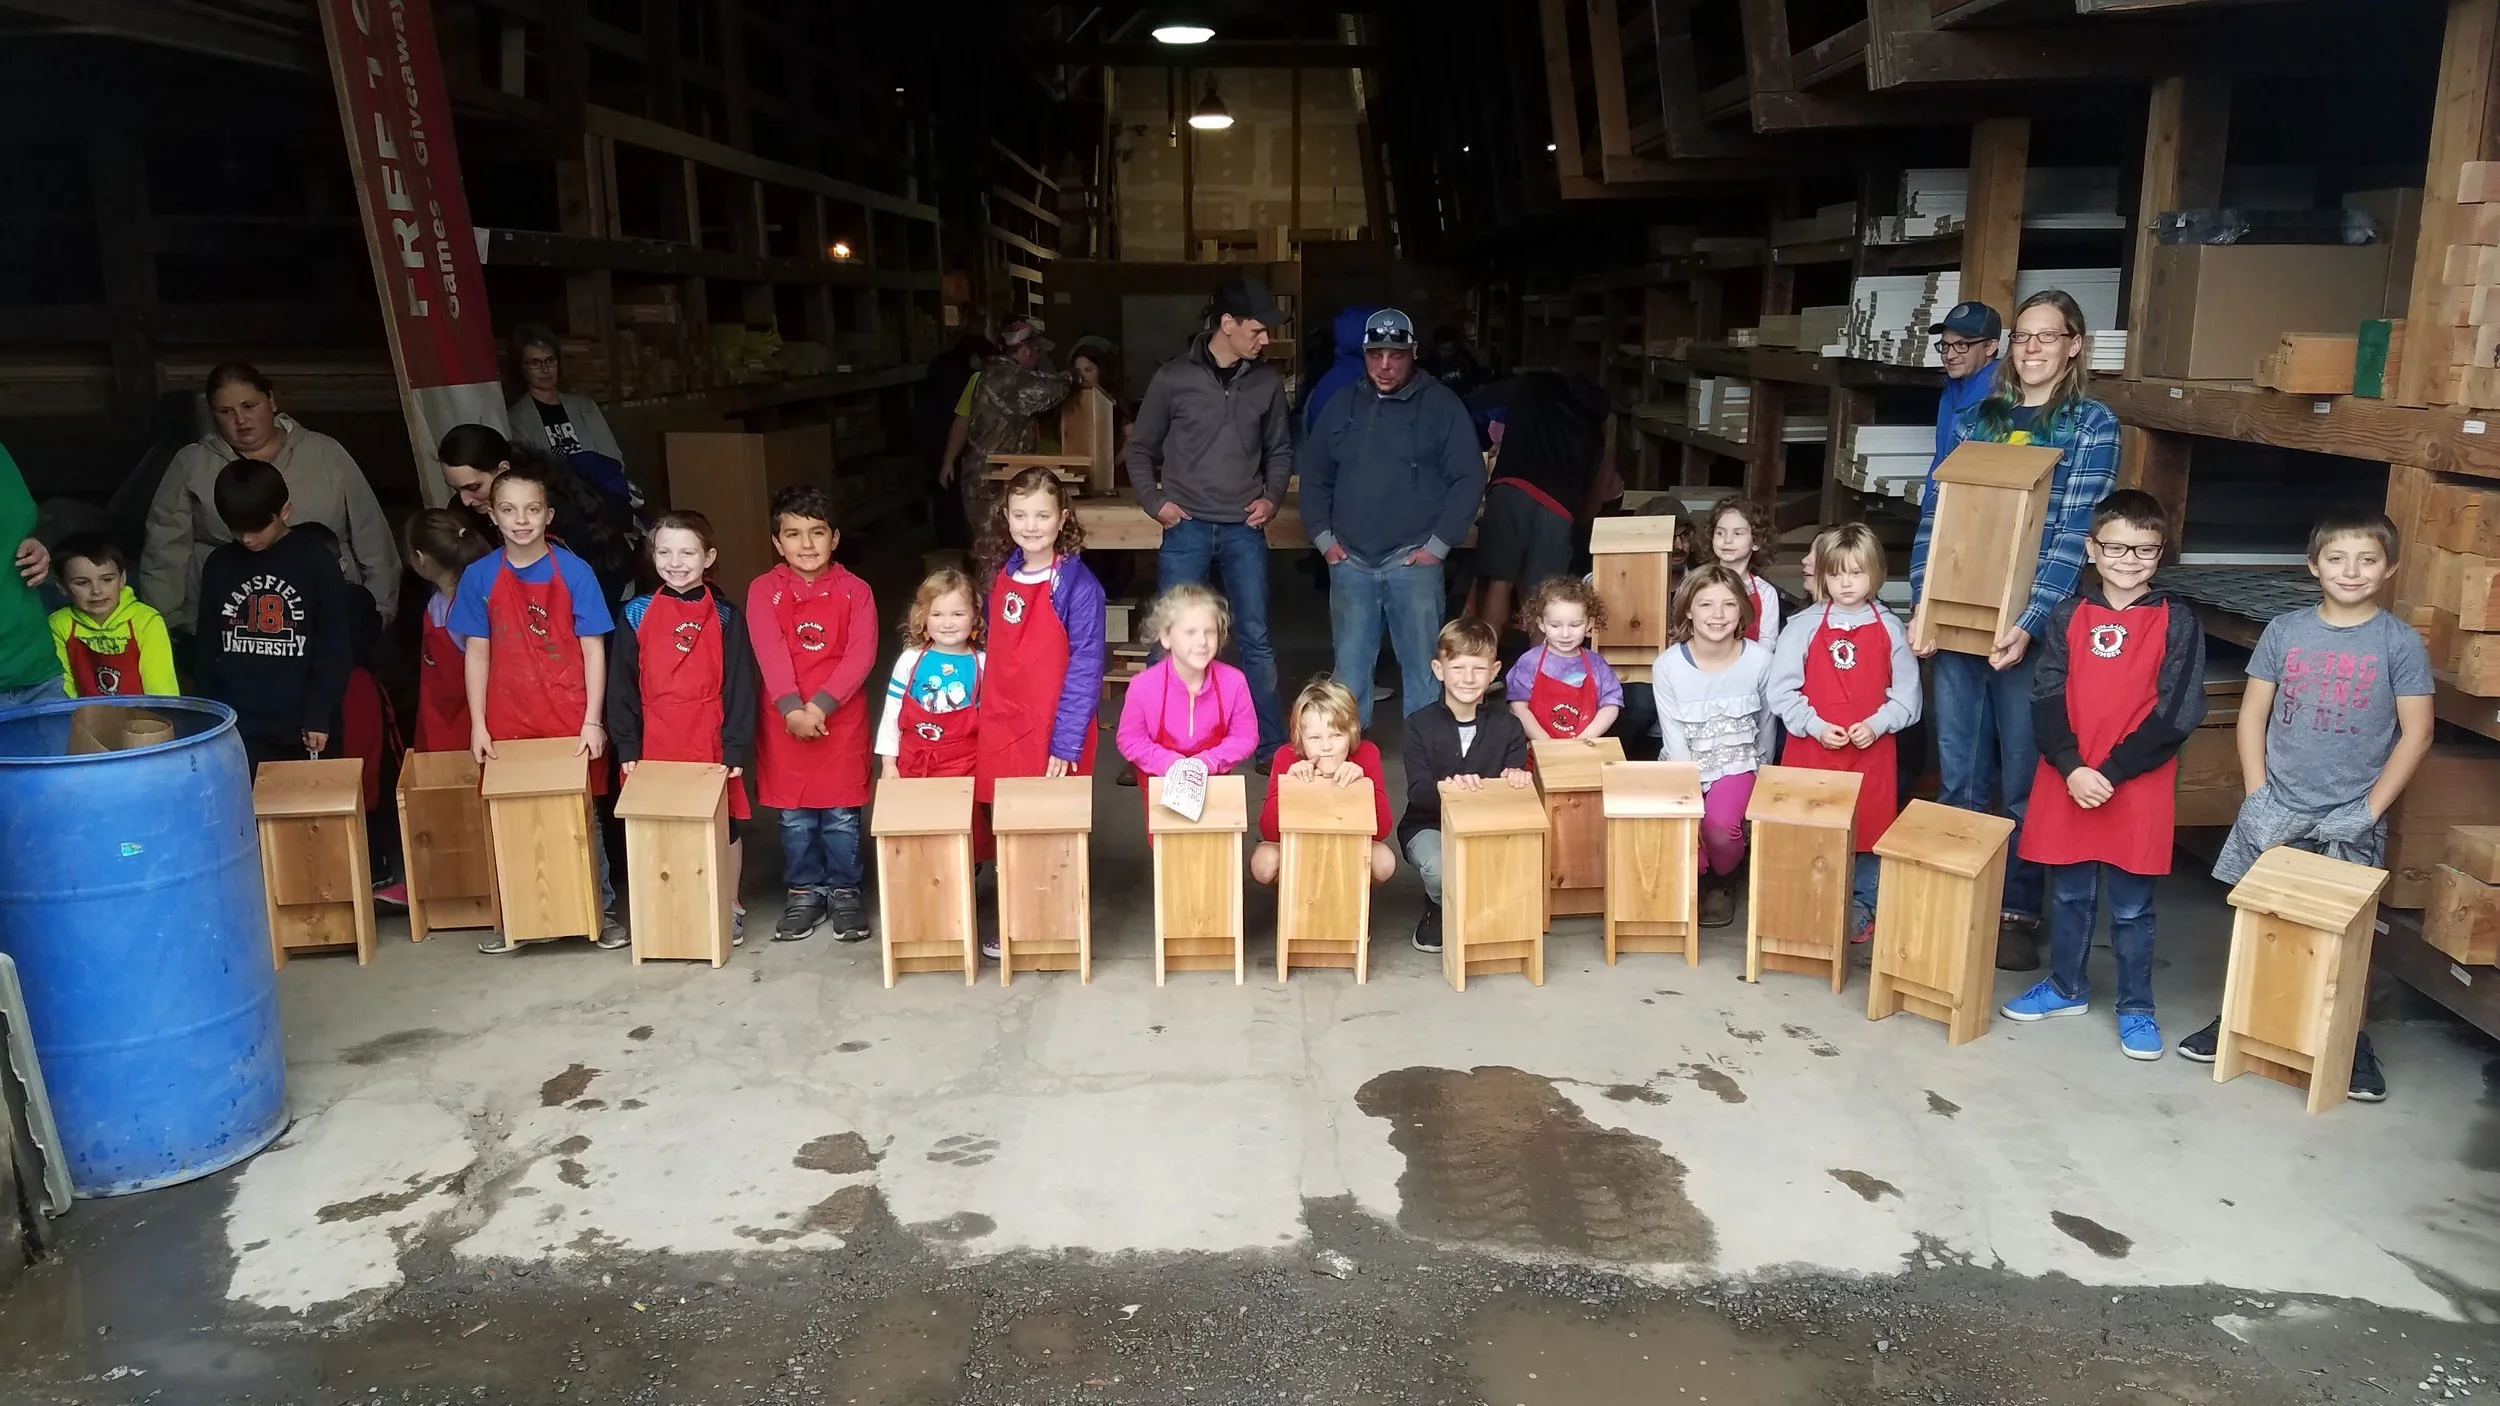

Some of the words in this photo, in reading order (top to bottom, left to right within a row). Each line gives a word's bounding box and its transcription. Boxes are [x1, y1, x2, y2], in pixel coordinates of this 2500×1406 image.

[221, 574, 305, 621] MANSFIELD
[247, 594, 284, 633] 18
[2090, 623, 2128, 636] TUM-A-LUM
[221, 630, 307, 657] UNIVERSITY
[2091, 646, 2123, 659] LUMBER
